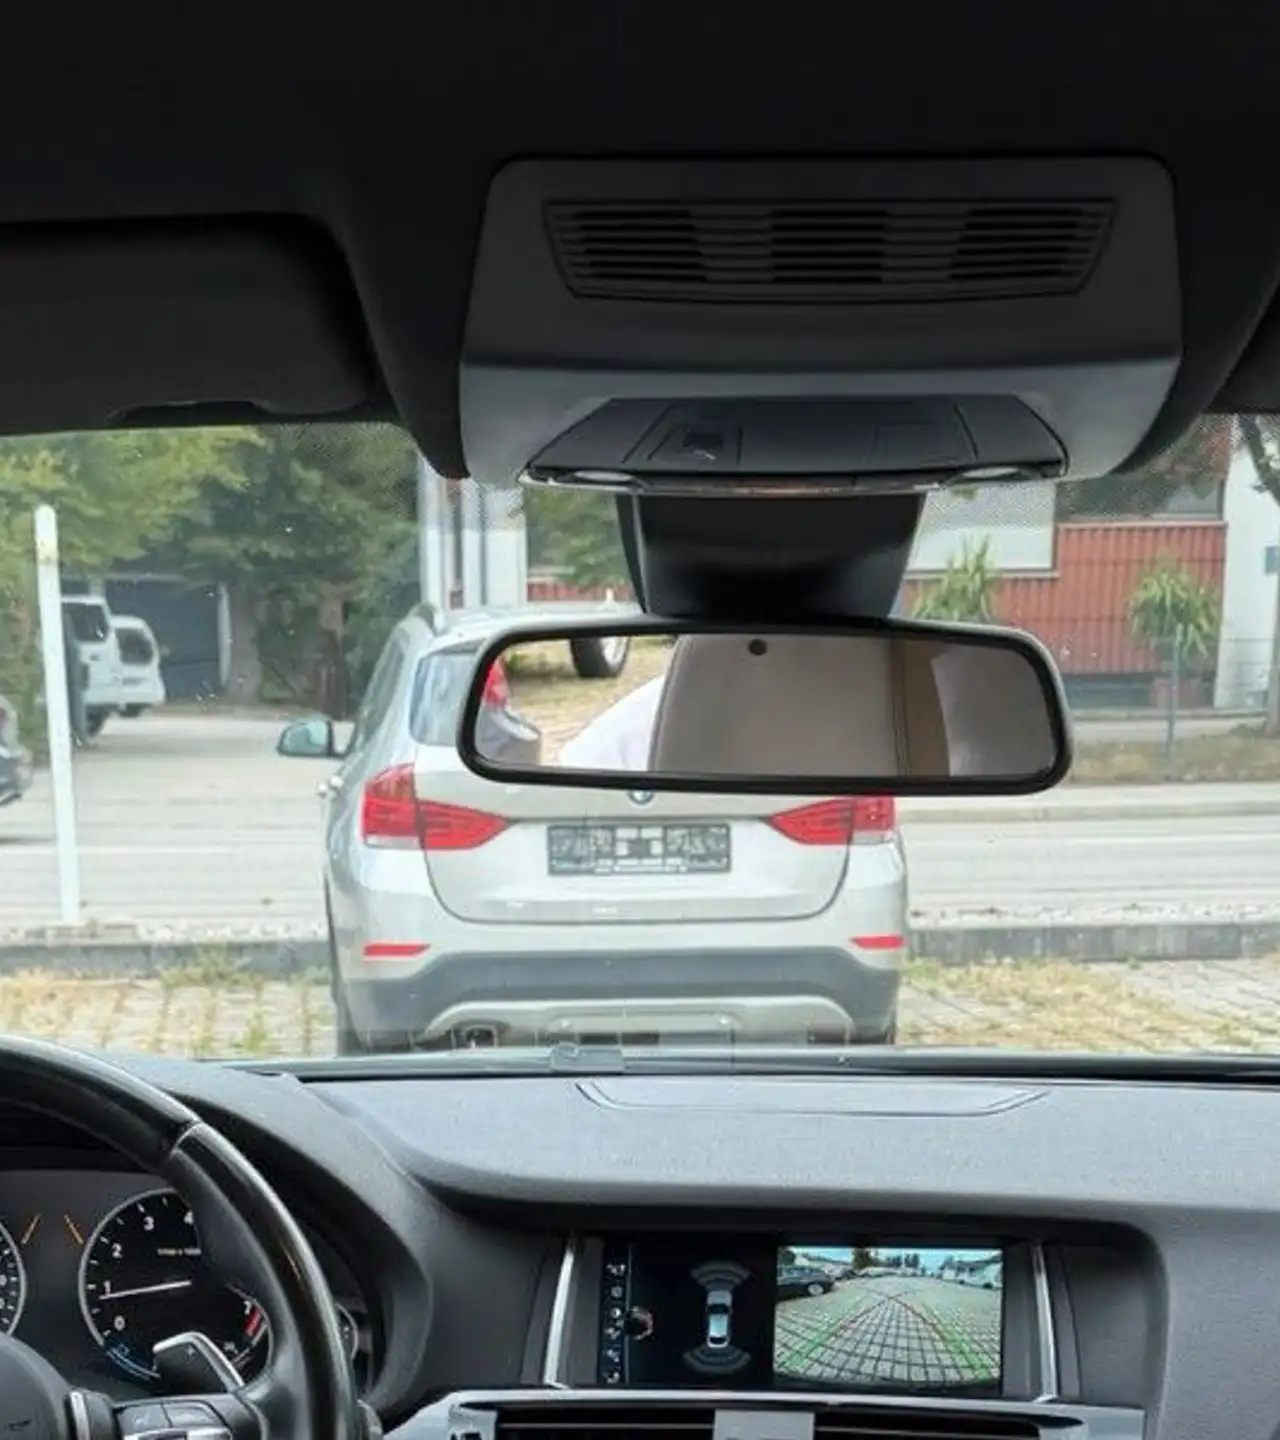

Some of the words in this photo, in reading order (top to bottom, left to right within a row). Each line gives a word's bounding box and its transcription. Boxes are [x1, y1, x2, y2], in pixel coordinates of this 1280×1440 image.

[143, 1216, 155, 1231] 3
[184, 1211, 194, 1225] 4
[111, 1243, 122, 1258] 2
[113, 1315, 126, 1331] 0
